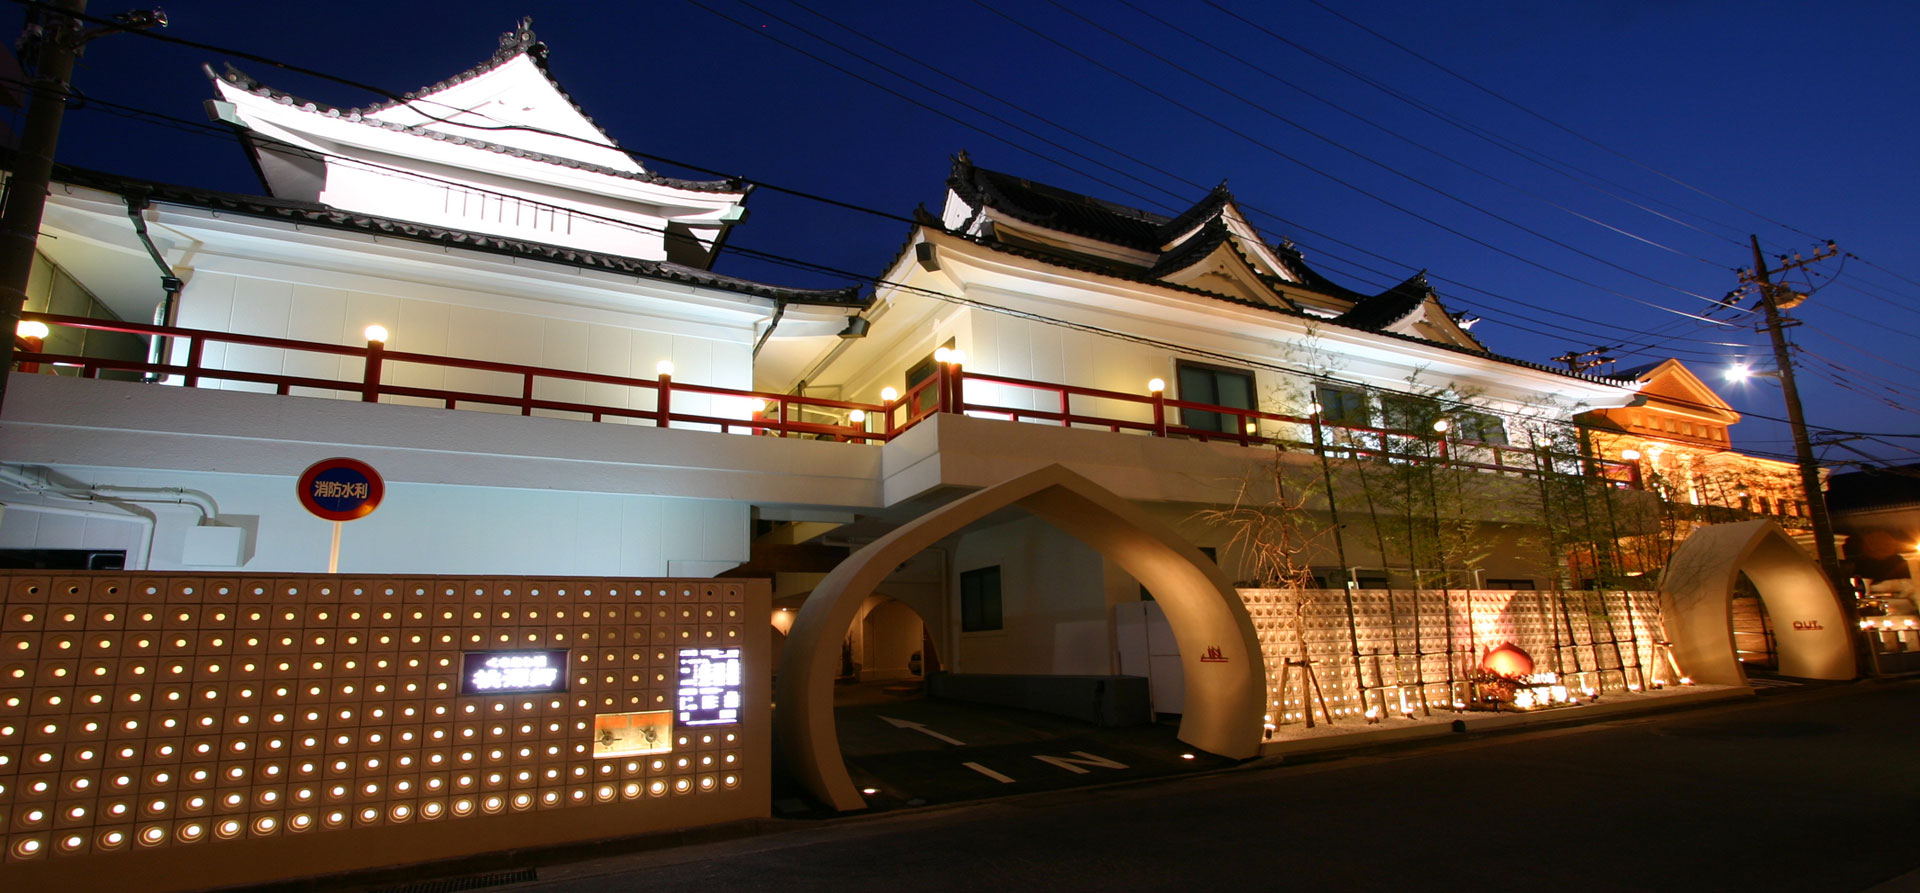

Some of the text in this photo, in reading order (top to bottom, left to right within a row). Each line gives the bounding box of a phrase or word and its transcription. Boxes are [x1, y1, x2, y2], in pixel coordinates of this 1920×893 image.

[314, 480, 369, 499] 消防水利
[962, 751, 1131, 784] IN
